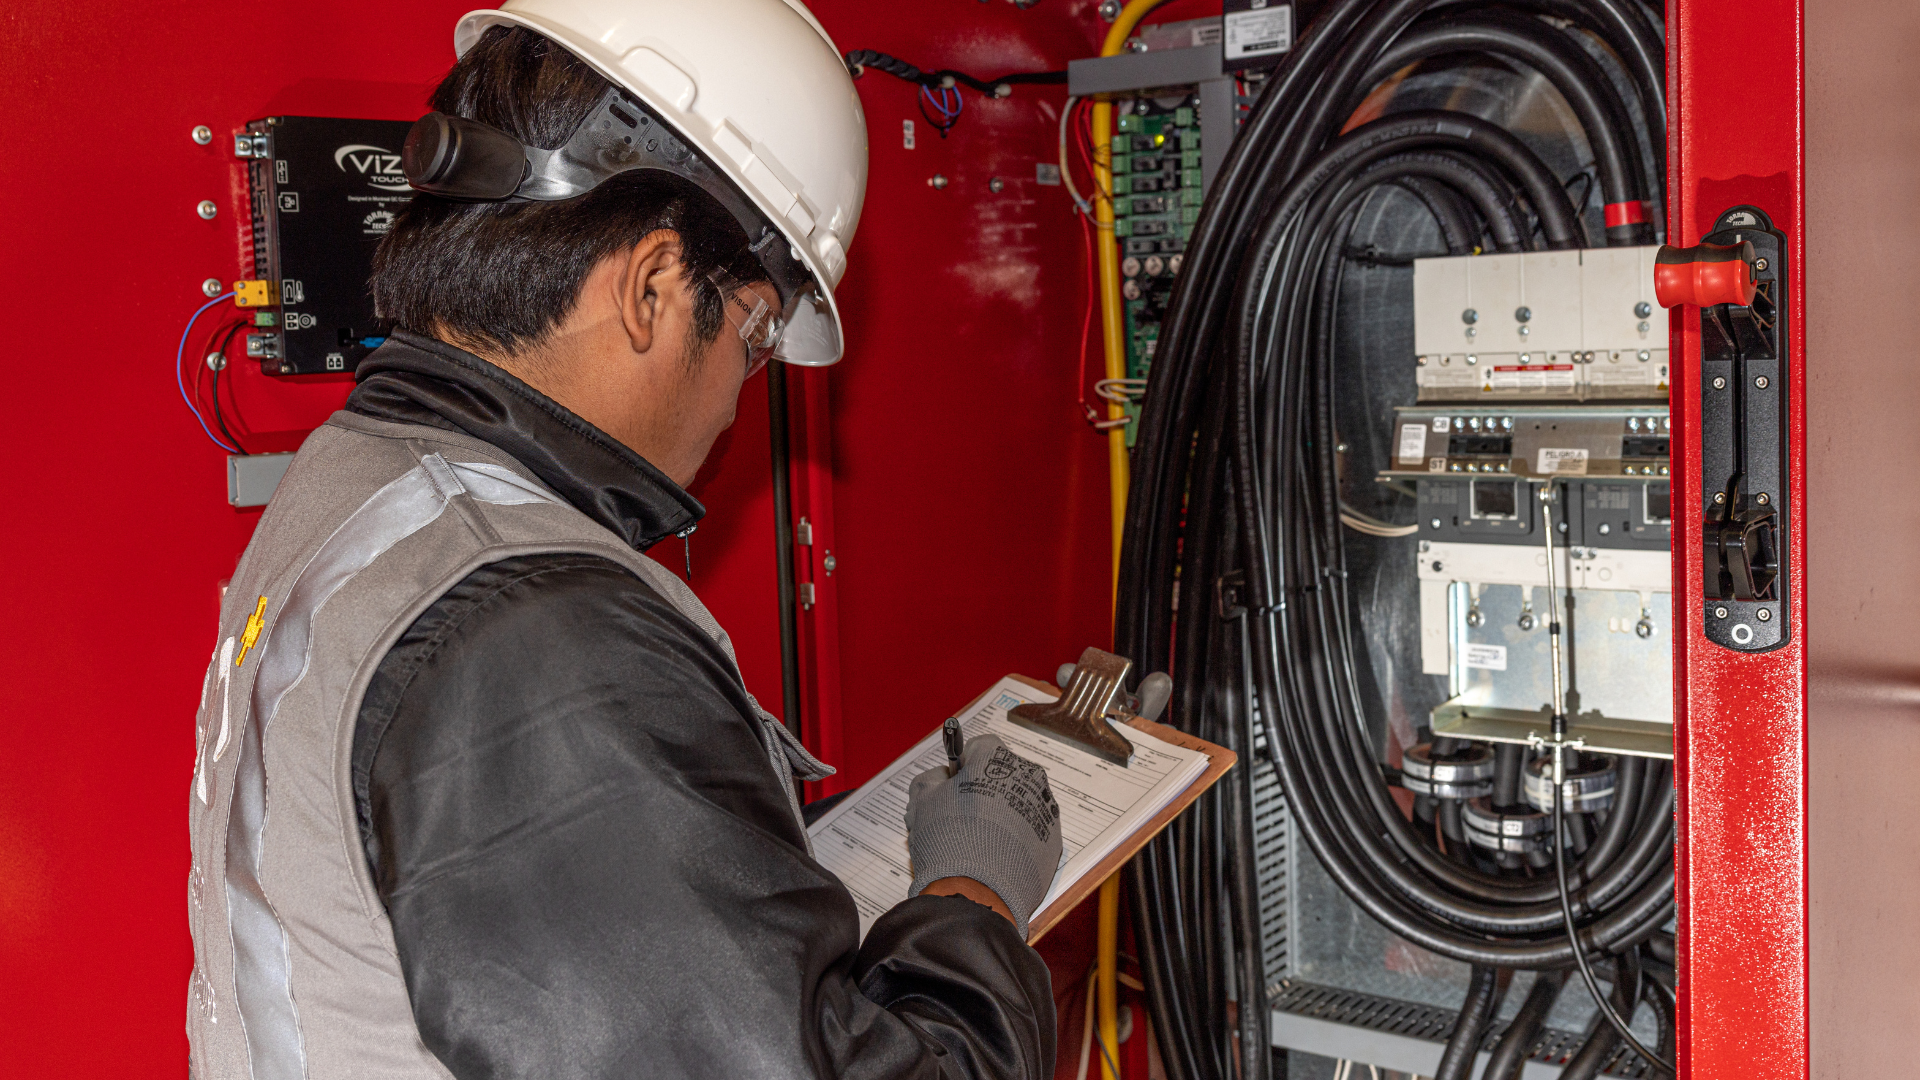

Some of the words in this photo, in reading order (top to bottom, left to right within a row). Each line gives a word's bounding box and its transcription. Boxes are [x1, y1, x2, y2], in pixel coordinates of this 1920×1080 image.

[730, 293, 753, 315] VISION
[1545, 450, 1575, 459] PELIGRO
[1430, 459, 1444, 470] ST
